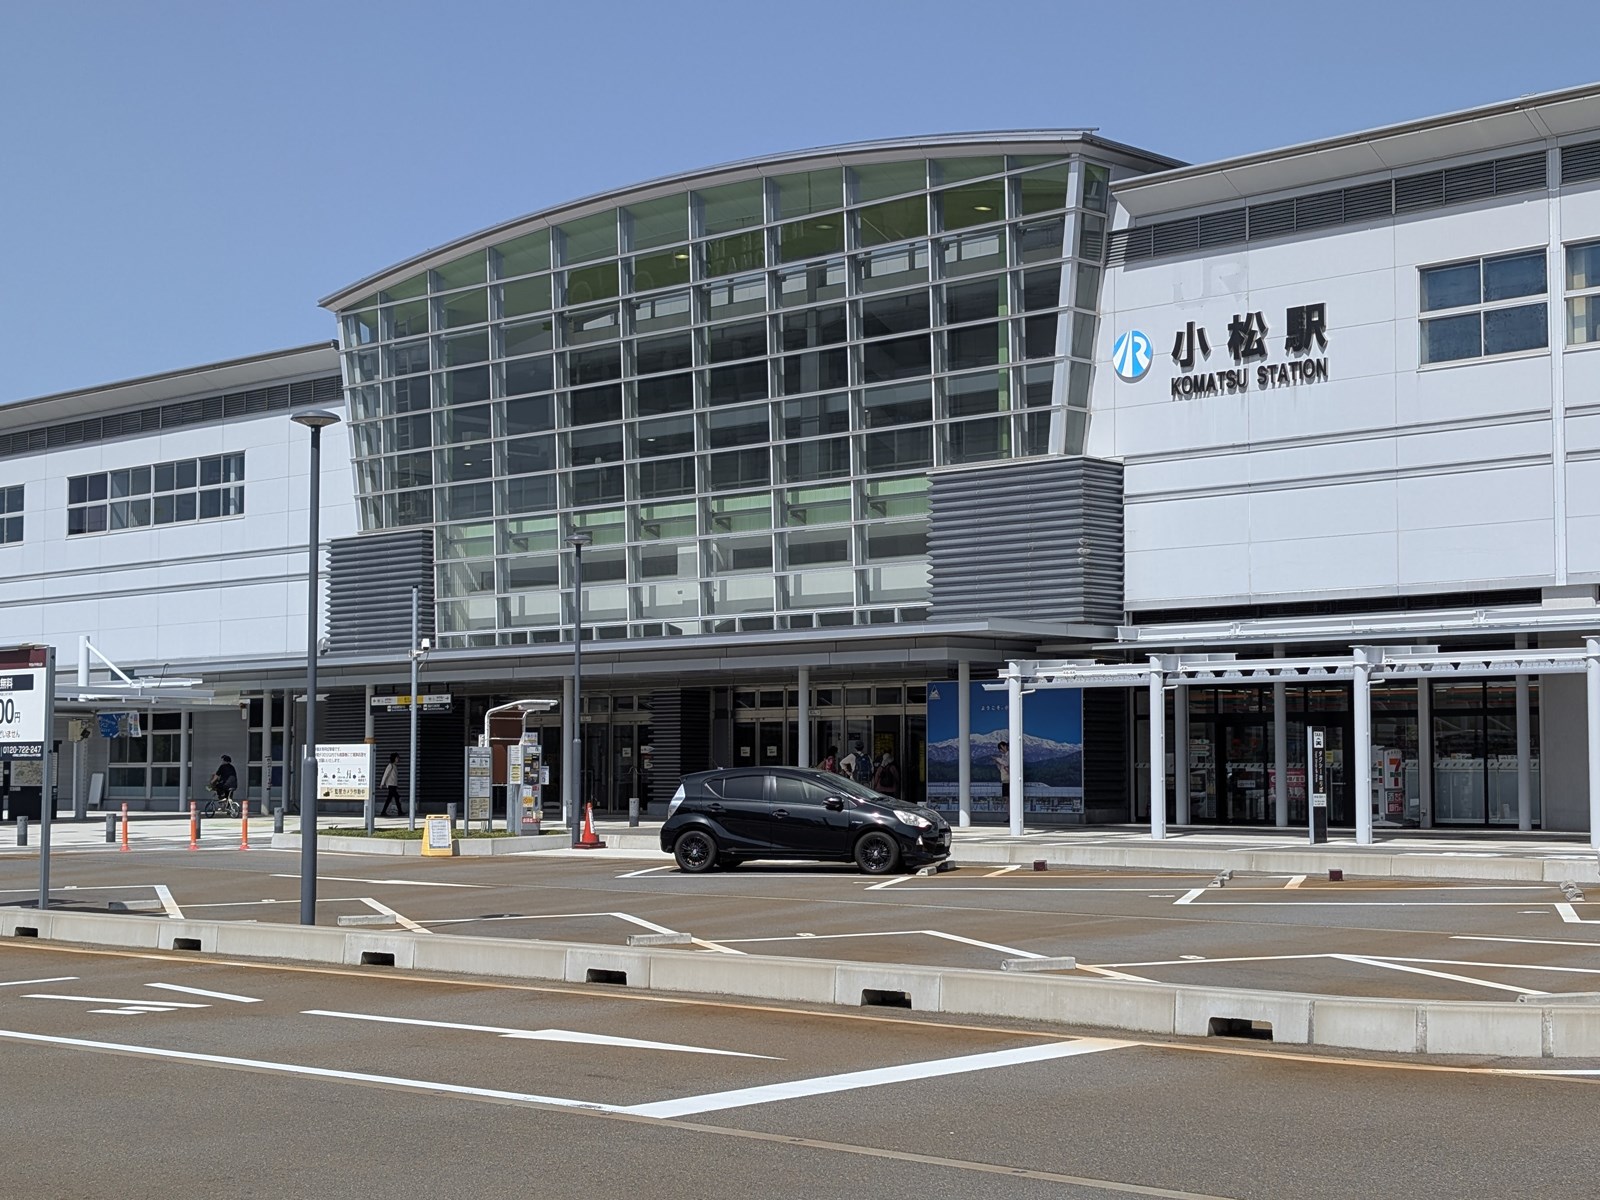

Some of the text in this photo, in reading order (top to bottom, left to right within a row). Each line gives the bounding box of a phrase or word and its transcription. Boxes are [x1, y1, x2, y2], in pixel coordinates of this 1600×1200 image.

[1171, 302, 1328, 368] 小松駅
[1171, 357, 1328, 396] KOMATSU STATION
[2, 745, 42, 754] 0120-722-247
